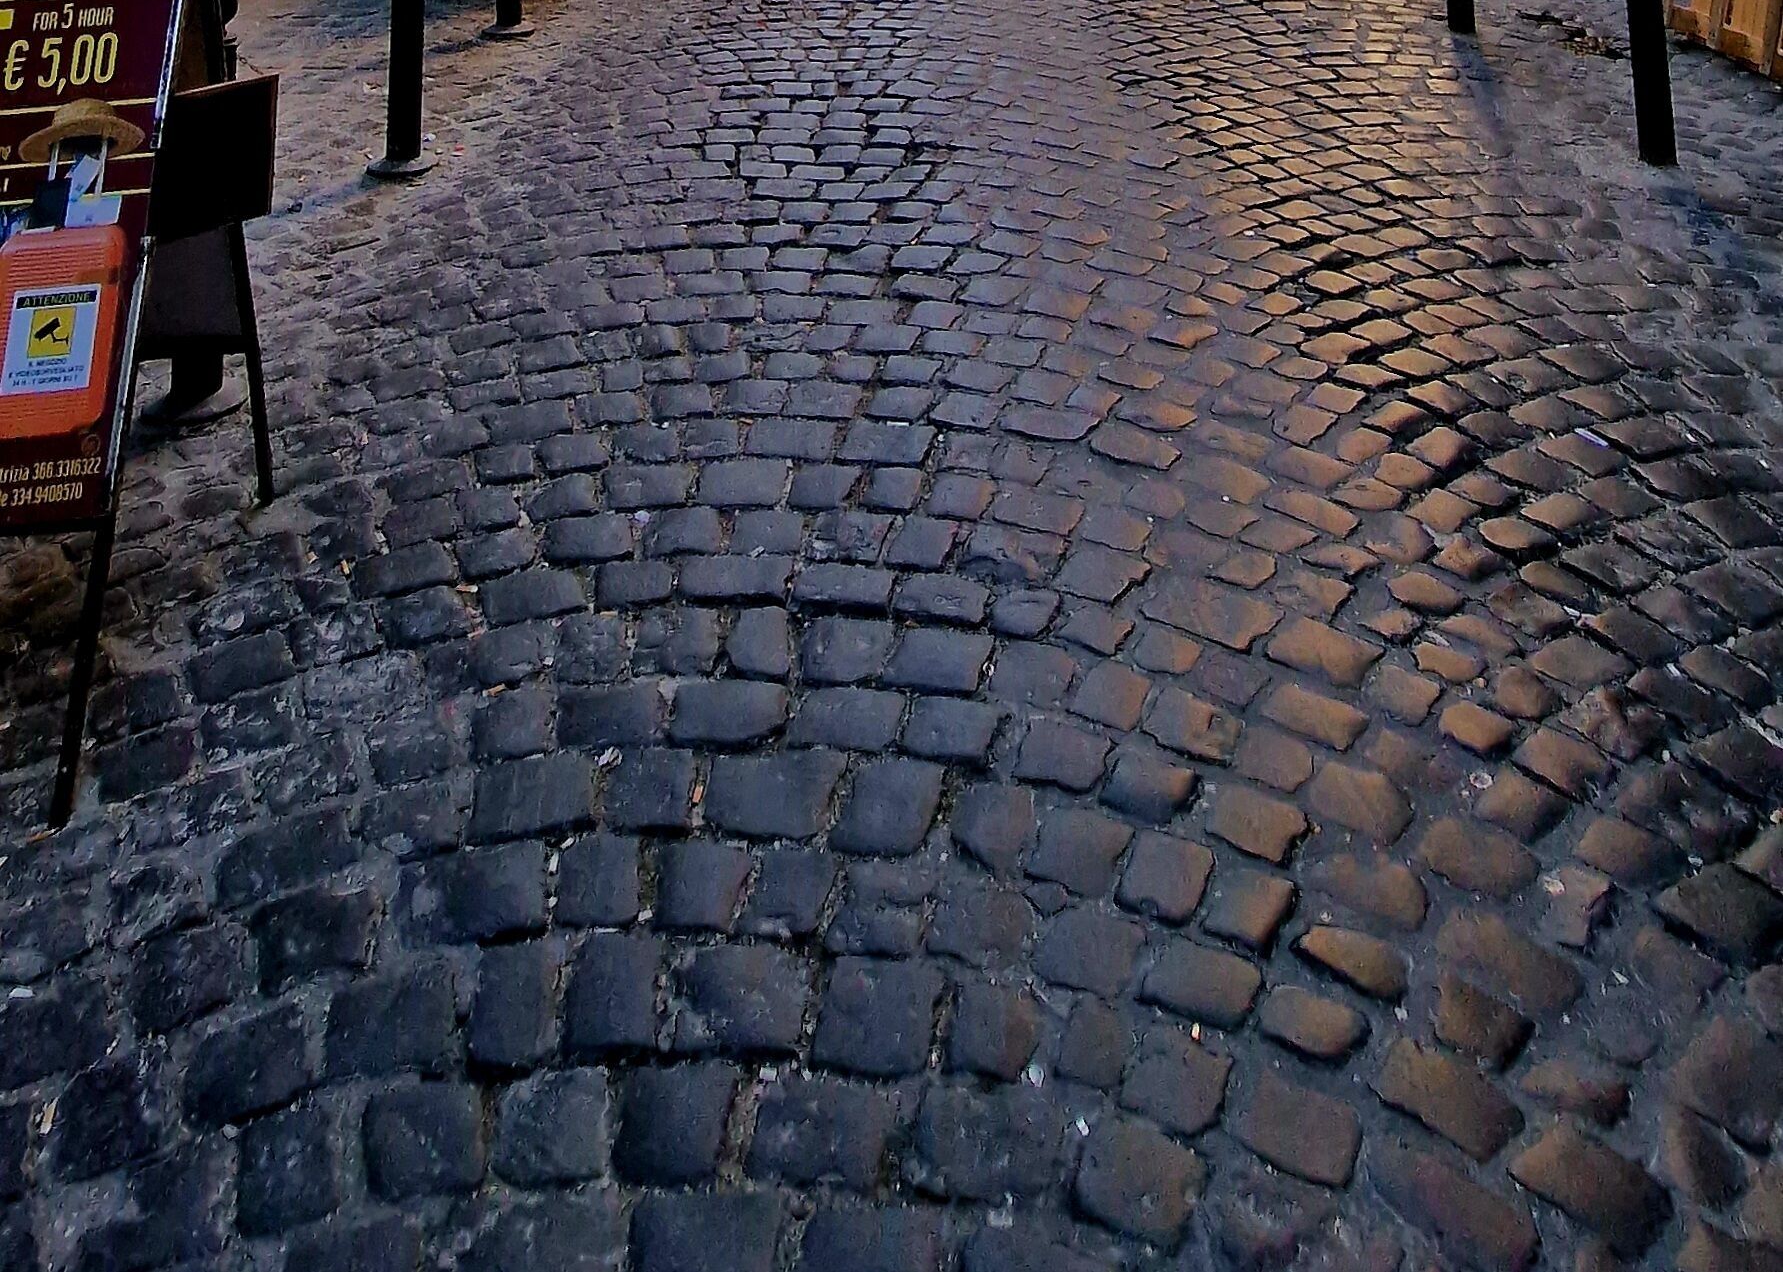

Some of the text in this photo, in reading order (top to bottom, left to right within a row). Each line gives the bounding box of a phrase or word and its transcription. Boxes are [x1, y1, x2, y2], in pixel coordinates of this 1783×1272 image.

[33, 3, 115, 31] FOR 5 HOUR
[3, 32, 119, 96] € 5,00
[23, 292, 91, 307] ATTENZIONE
